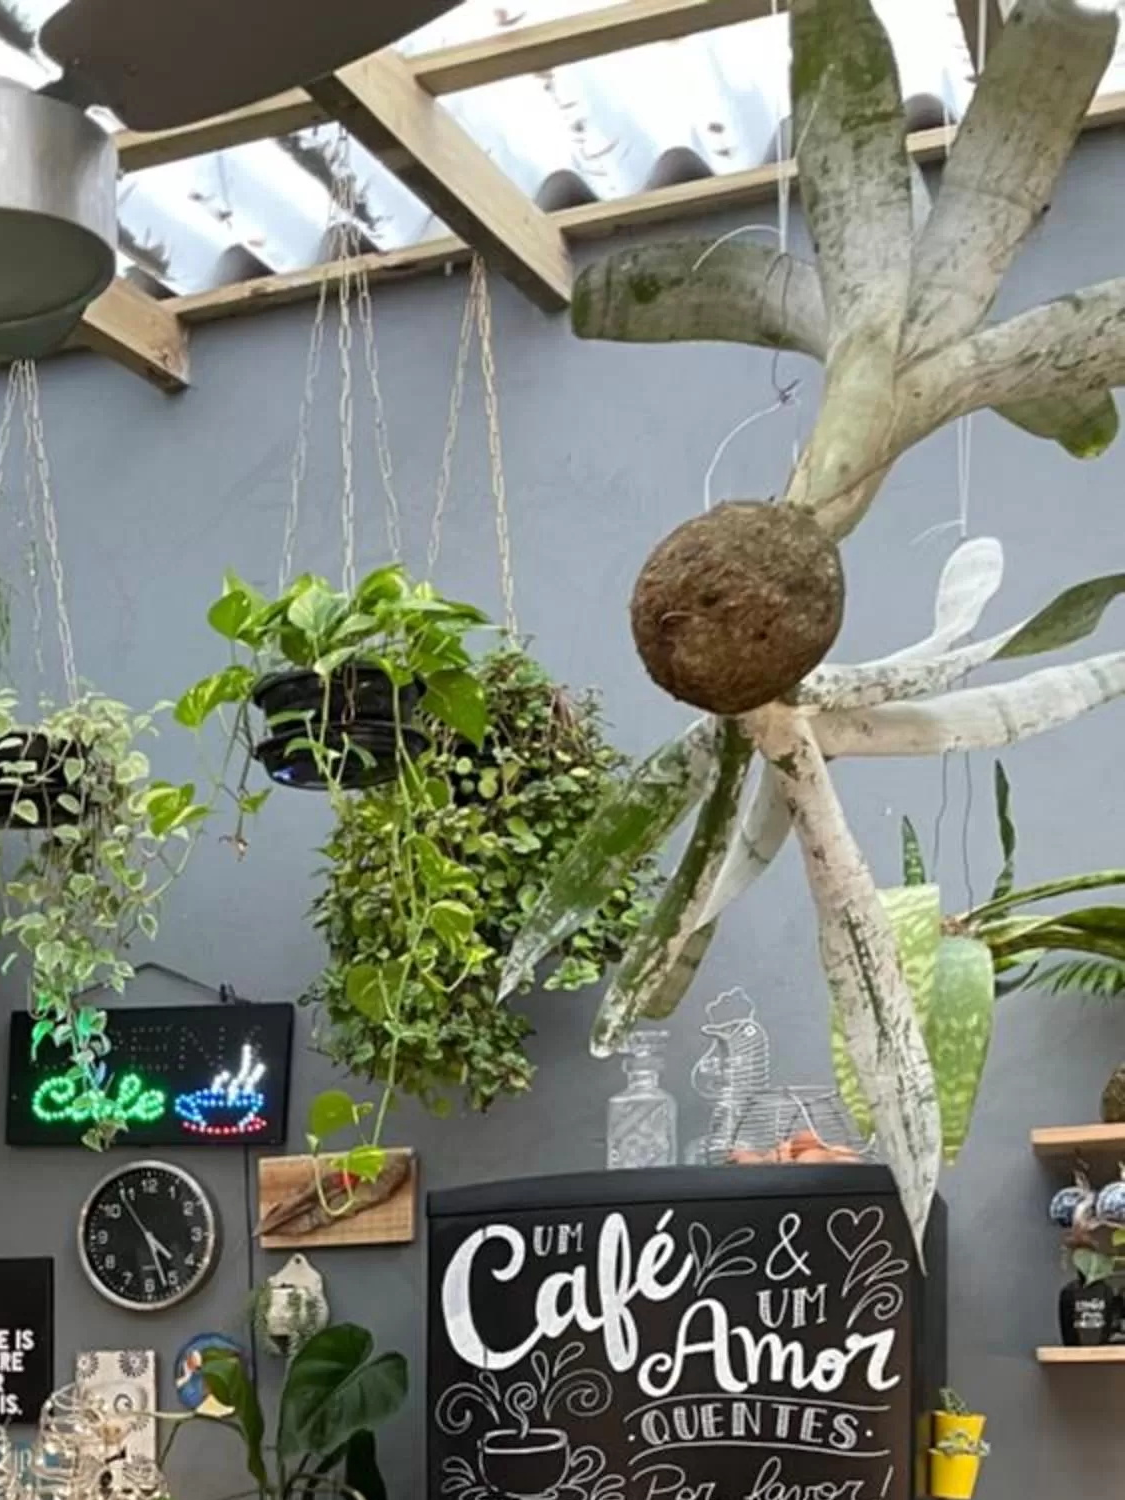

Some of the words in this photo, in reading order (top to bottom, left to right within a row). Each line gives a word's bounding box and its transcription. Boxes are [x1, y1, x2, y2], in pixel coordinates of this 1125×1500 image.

[141, 1177, 158, 1194] 12
[104, 1203, 121, 1218] 10
[182, 1201, 194, 1216] 2
[97, 1230, 108, 1245] 9
[191, 1226, 203, 1242] 3
[532, 1224, 584, 1257] UM
[105, 1254, 116, 1269] 8
[184, 1253, 195, 1265] 4
[122, 1271, 133, 1285] 7
[144, 1278, 156, 1292] 6
[167, 1270, 179, 1285] 5
[441, 1208, 695, 1373] Café
[756, 1283, 828, 1330] UM
[15, 1329, 35, 1351] IS
[637, 1298, 901, 1397] Amor
[0, 1393, 23, 1415] IS.
[640, 1401, 859, 1450] QUENTES
